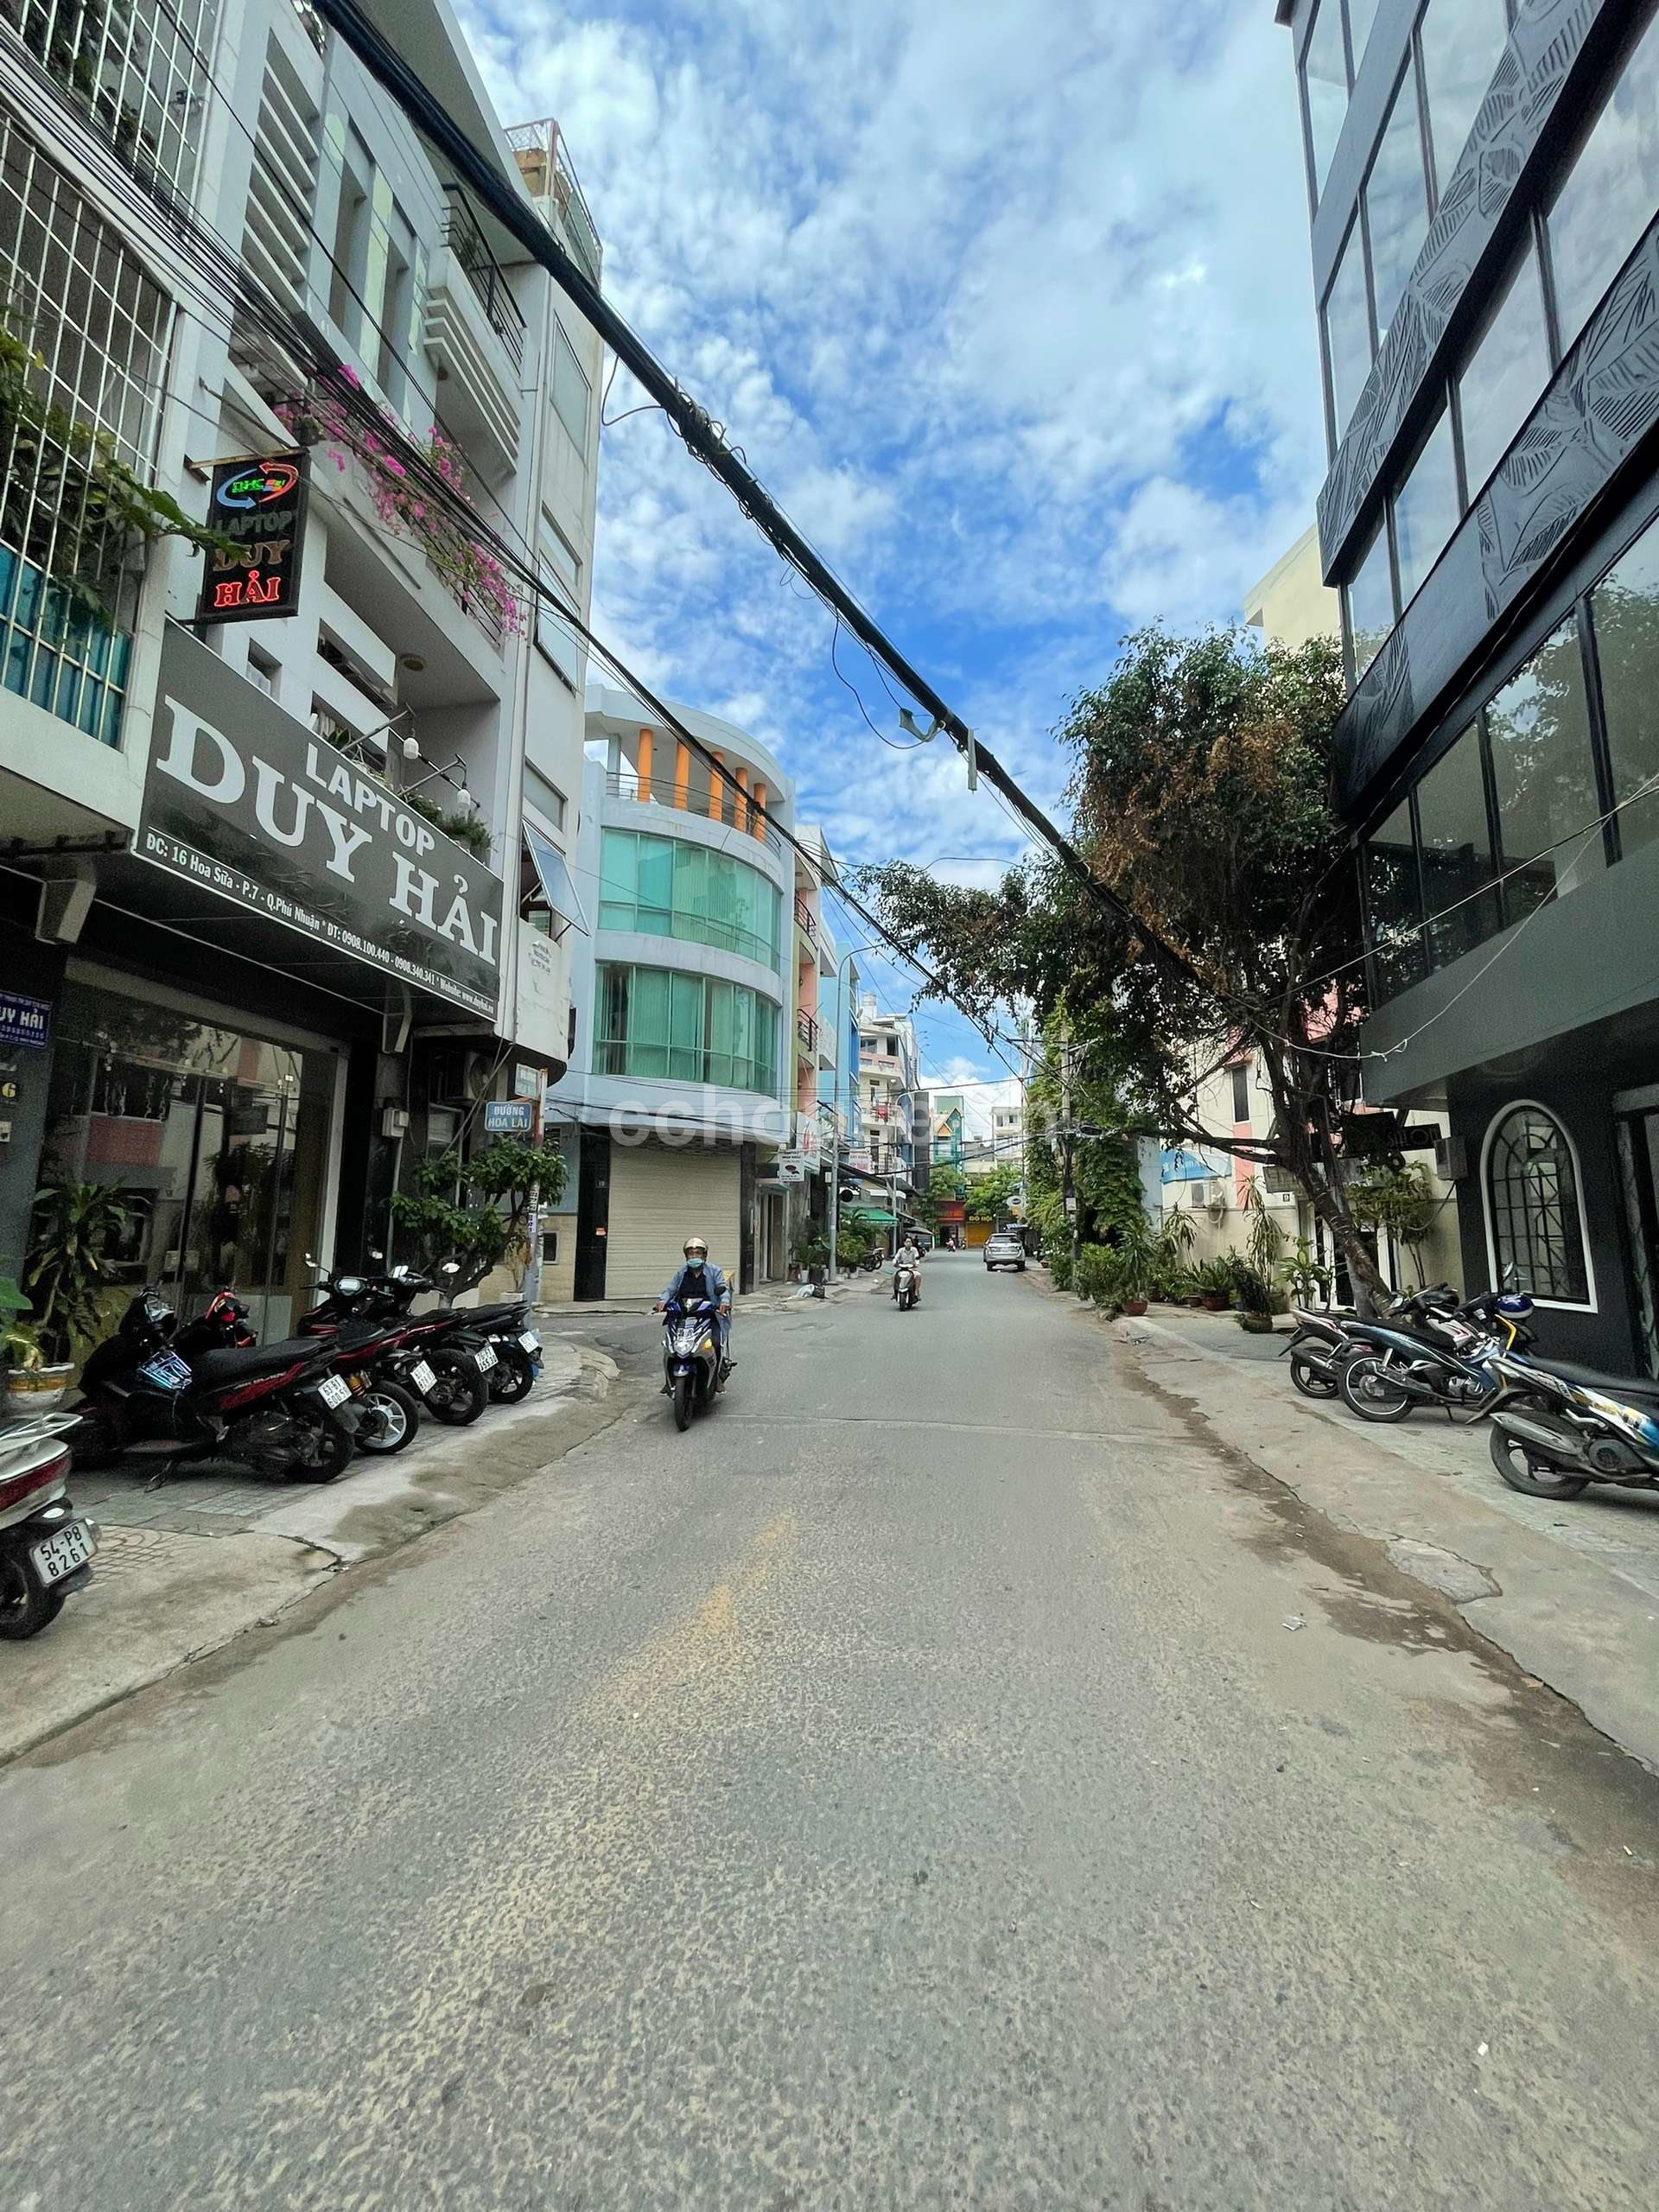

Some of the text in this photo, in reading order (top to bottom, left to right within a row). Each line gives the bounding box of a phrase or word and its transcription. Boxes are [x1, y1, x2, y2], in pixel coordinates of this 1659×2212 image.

[214, 570, 281, 607] HẢI
[306, 742, 435, 856] LAPTOP
[156, 694, 498, 966] DUY HẢI
[146, 833, 168, 857] ĐC:
[172, 846, 188, 866] 16
[189, 854, 211, 878] Hoa
[213, 867, 233, 889] Sữa
[242, 880, 259, 900] P.7
[266, 893, 292, 917] Q.Phú
[327, 923, 341, 940] ĐT:
[487, 1118, 508, 1128] HOA
[40, 1525, 82, 1560] 54-P8
[48, 1542, 88, 1577] 8261
